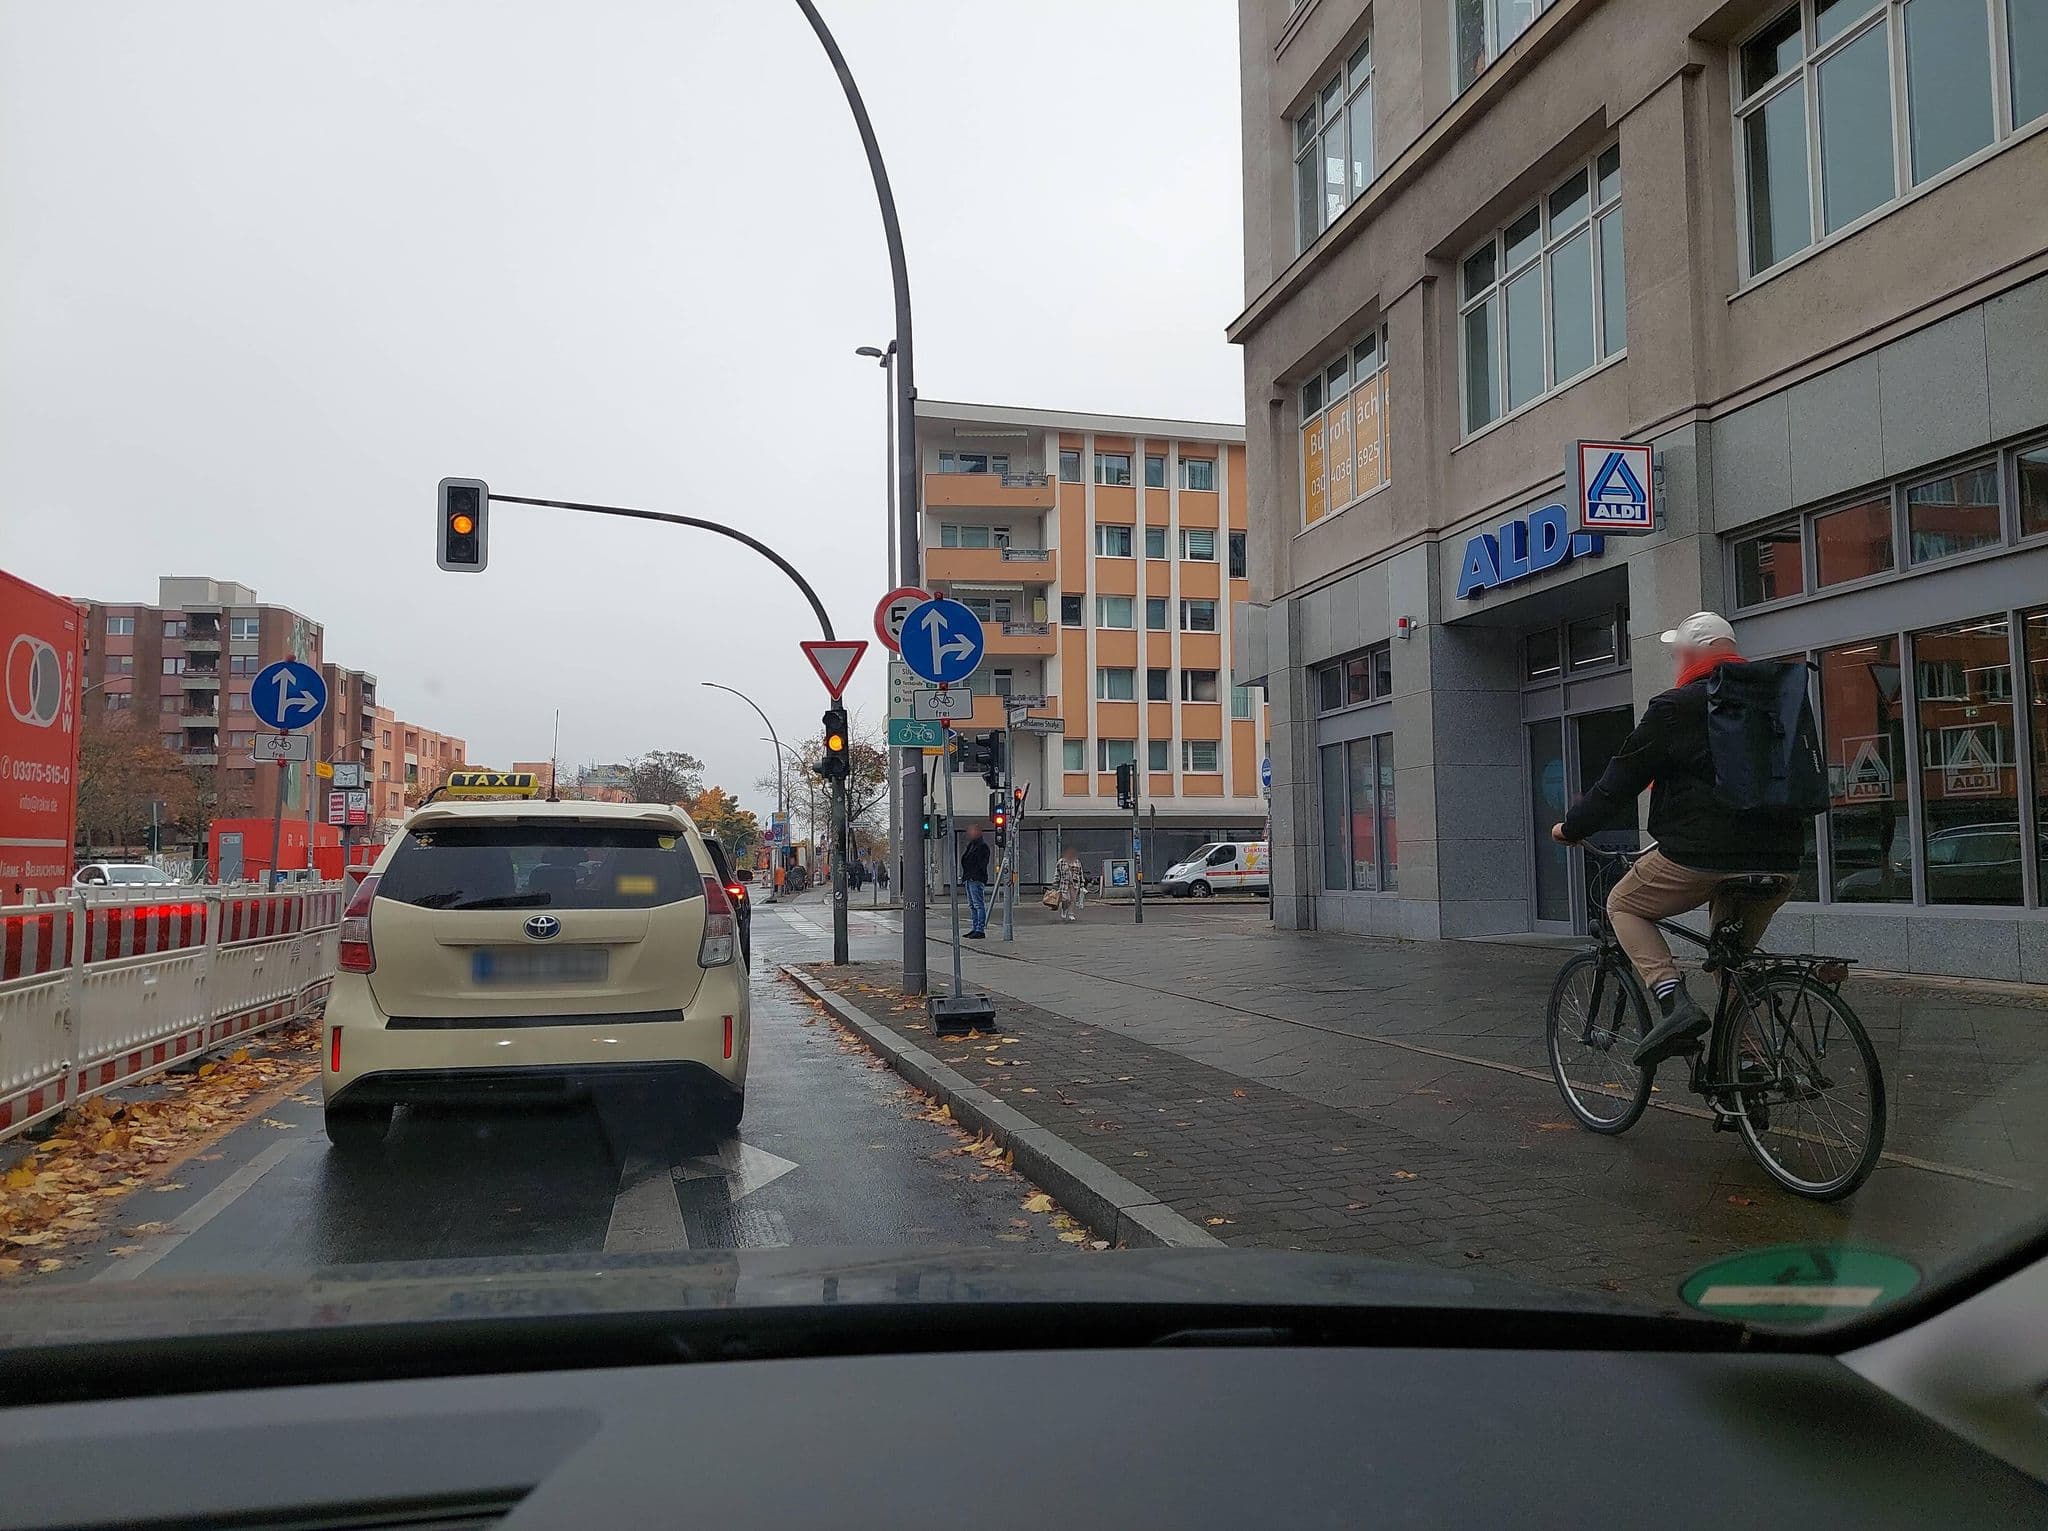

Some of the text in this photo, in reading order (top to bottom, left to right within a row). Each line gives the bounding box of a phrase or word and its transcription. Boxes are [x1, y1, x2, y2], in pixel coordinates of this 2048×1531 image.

[1594, 503, 1642, 519] ALDI
[891, 606, 908, 636] 5
[62, 650, 74, 734] RAKW
[936, 709, 950, 718] frei
[12, 760, 70, 785] 03375-515-0
[462, 773, 522, 786] TAXI
[1853, 782, 1886, 796] ALDI
[1953, 774, 1993, 790] ALDI
